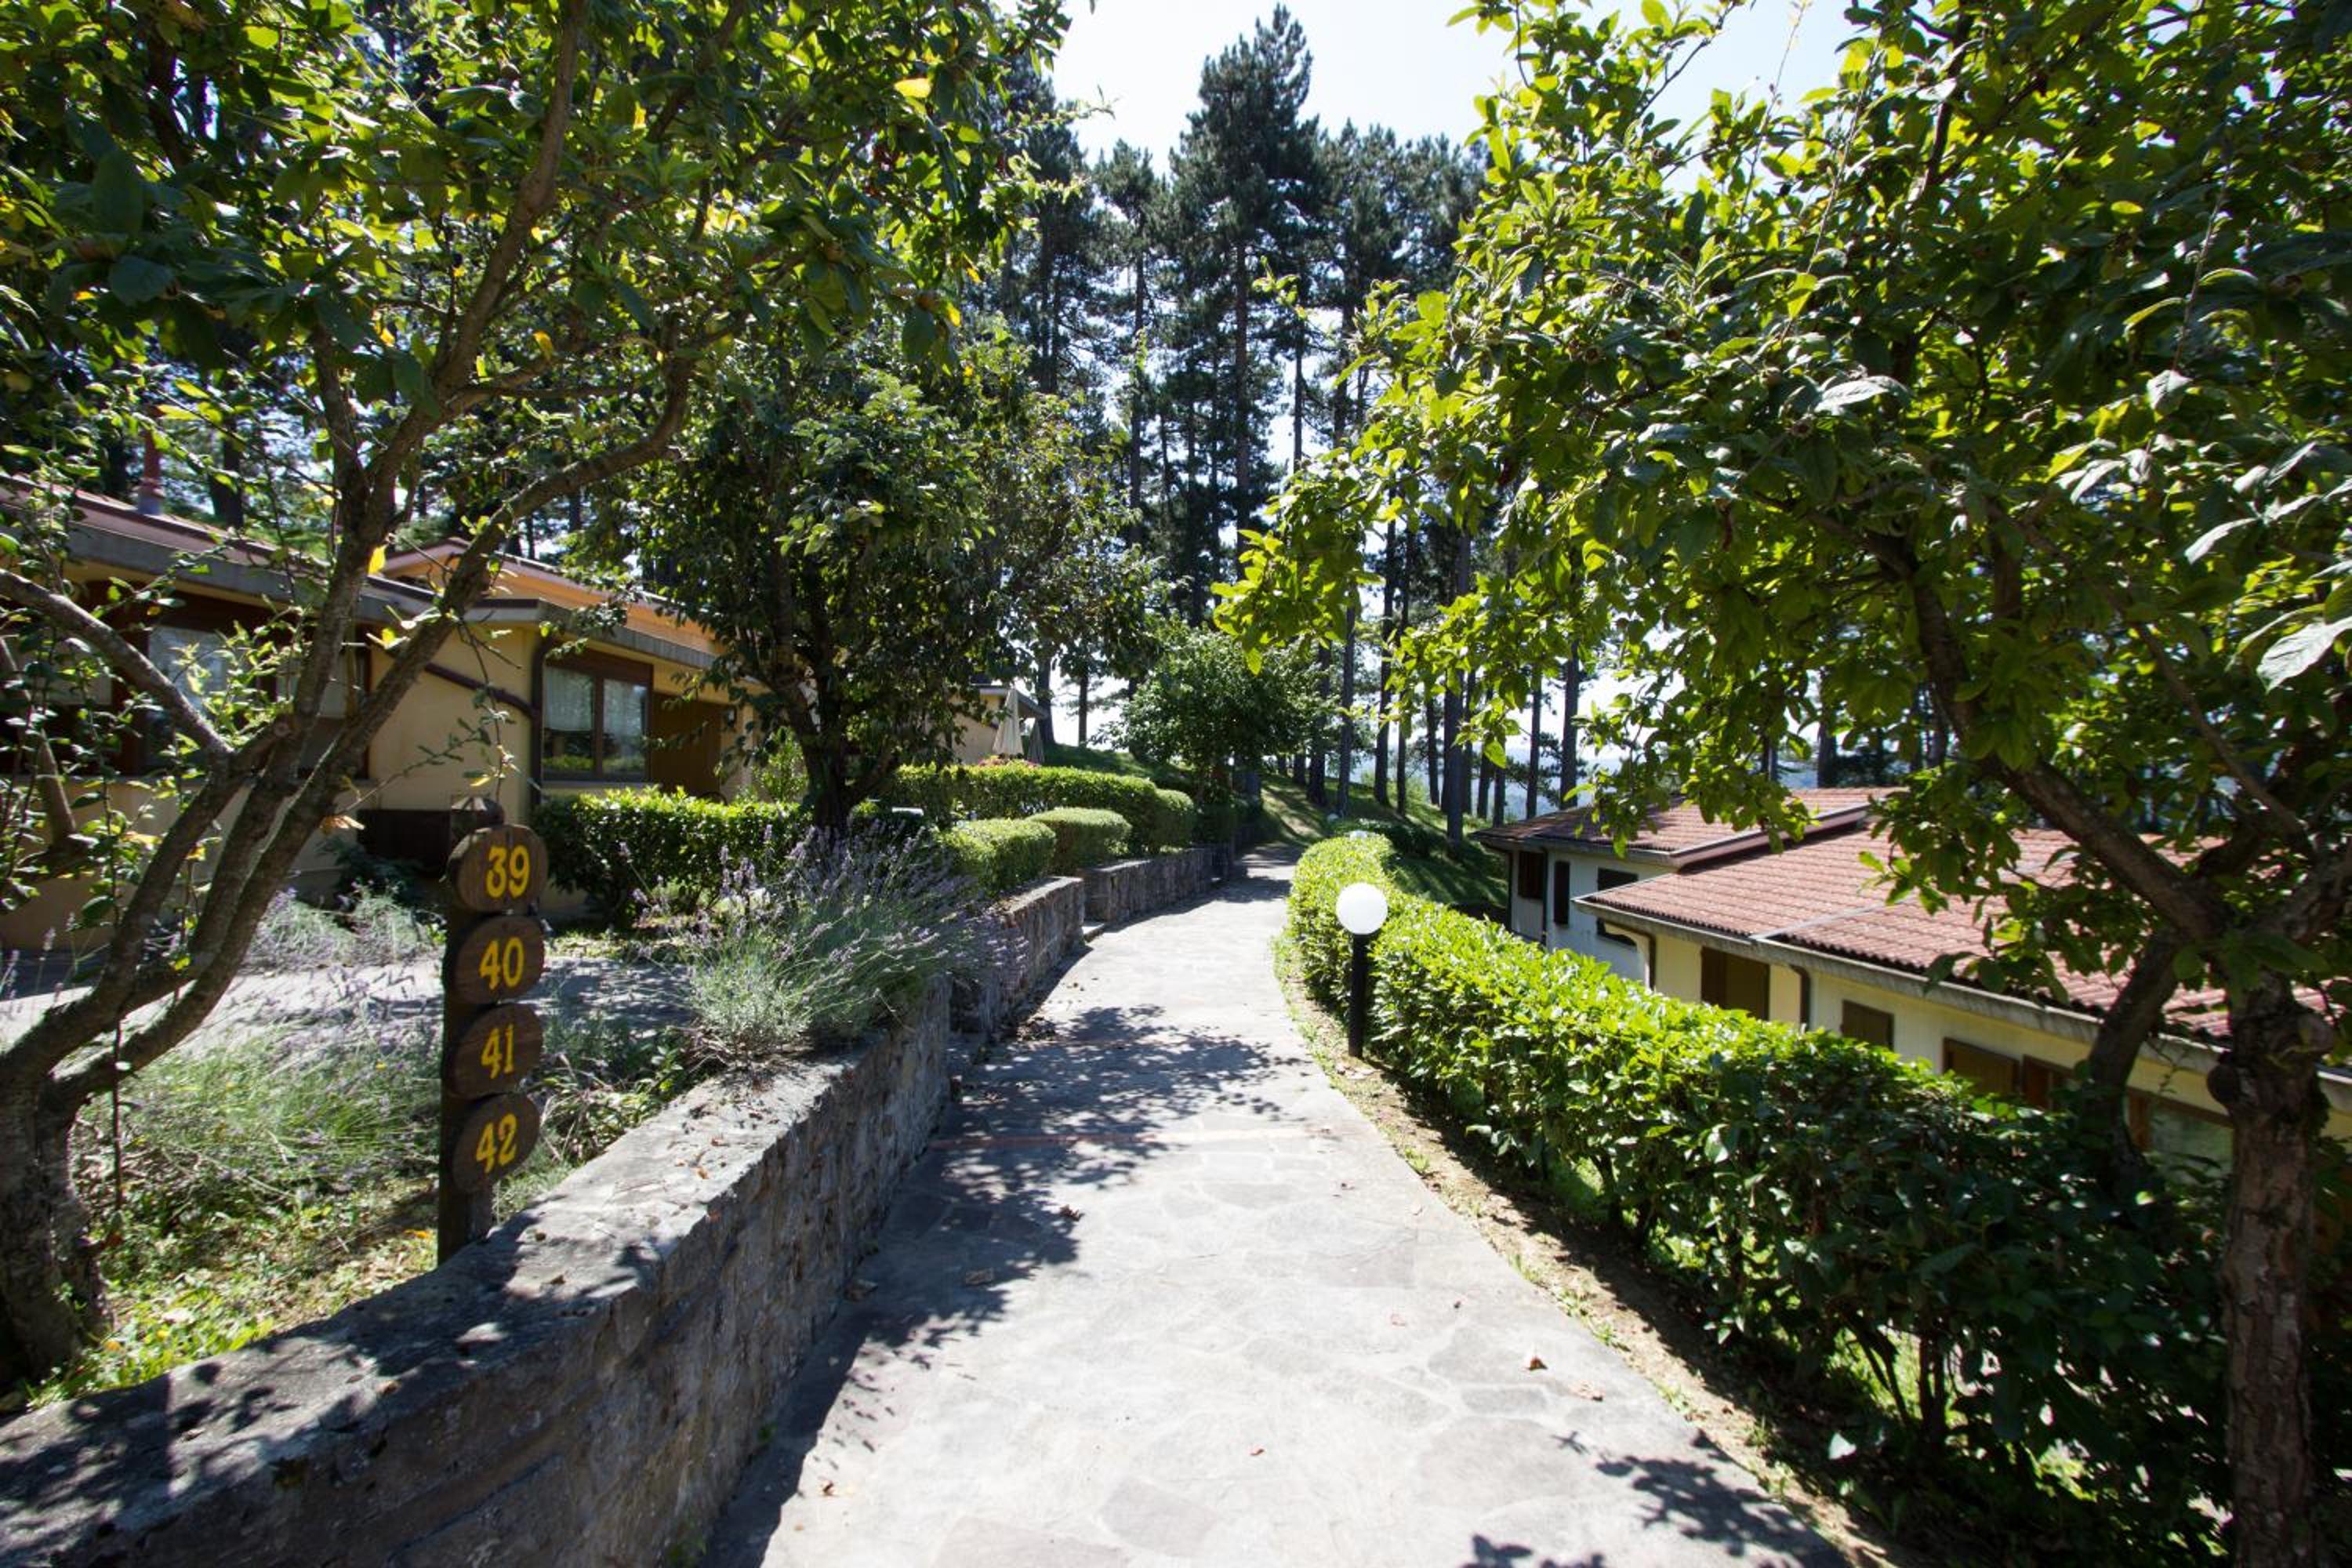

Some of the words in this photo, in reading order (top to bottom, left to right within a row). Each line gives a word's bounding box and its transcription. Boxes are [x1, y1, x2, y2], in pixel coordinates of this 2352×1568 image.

[486, 845, 529, 898] 39
[479, 936, 524, 990] 40
[481, 1023, 514, 1080] 41
[476, 1113, 517, 1174] 42
